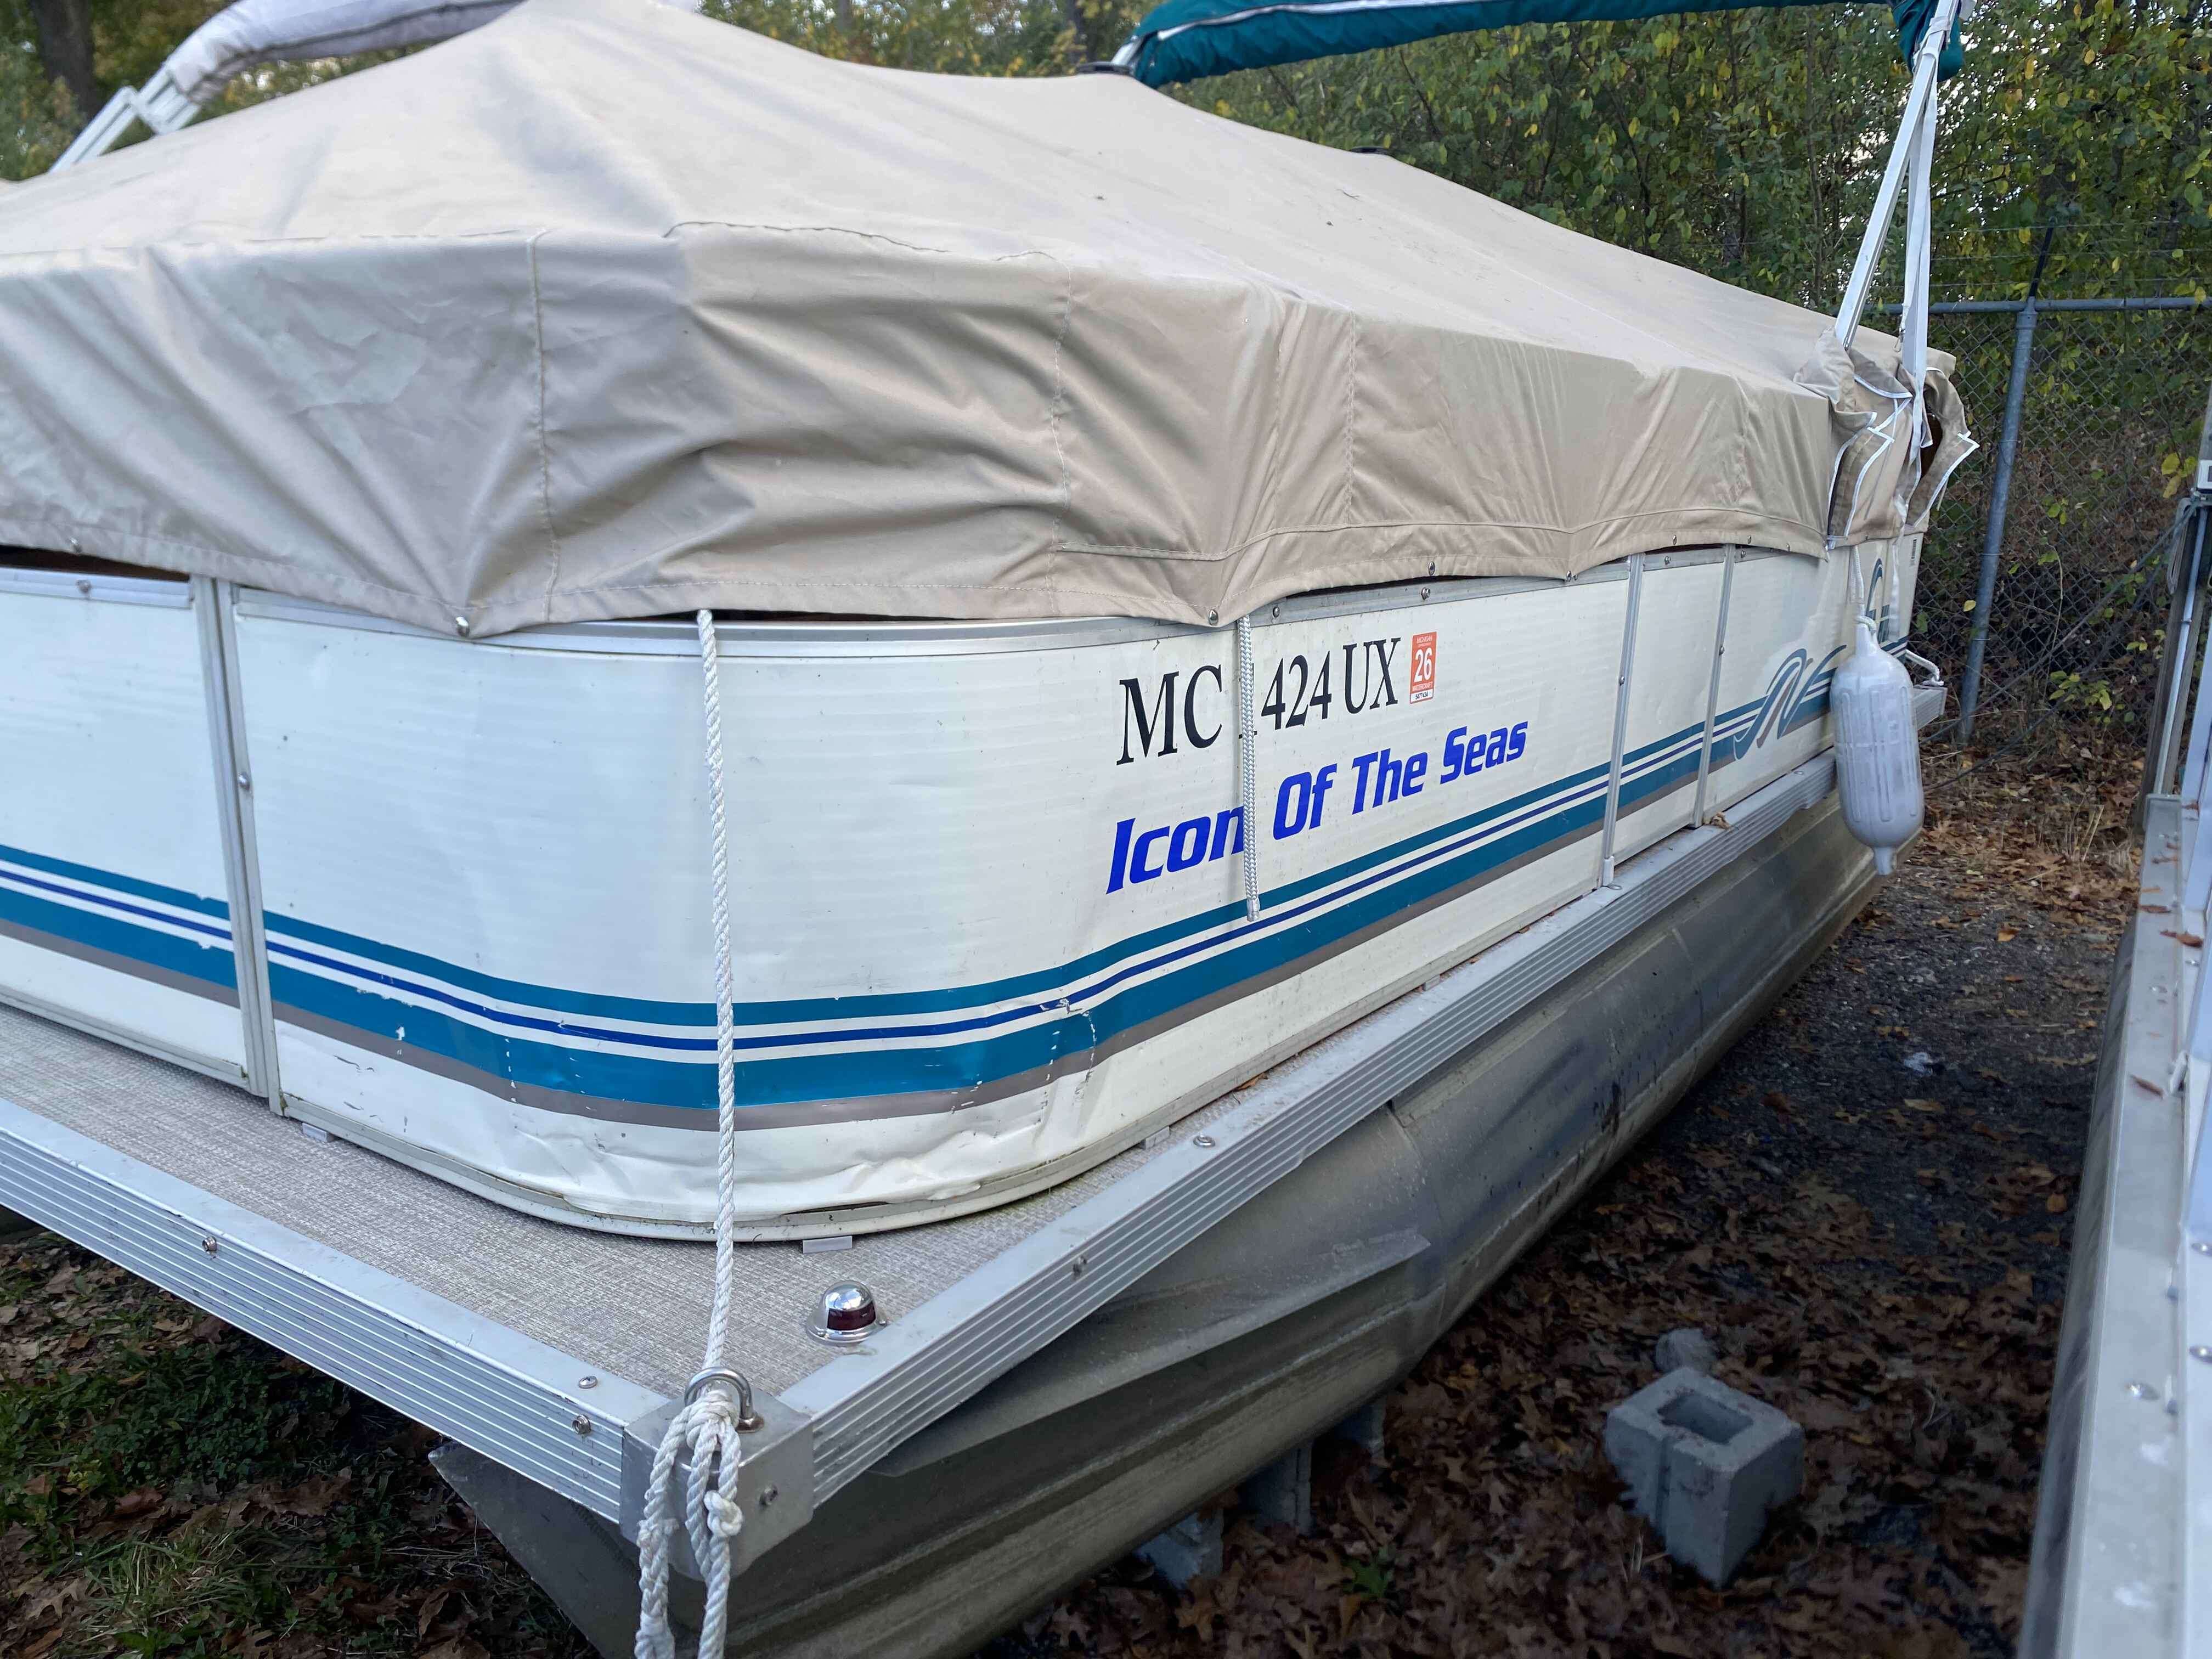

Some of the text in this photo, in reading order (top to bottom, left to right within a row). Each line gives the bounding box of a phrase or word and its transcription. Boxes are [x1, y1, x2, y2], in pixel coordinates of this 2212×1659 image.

[1116, 637, 1401, 766] MC 424 UX
[1413, 647, 1432, 683] 26
[1106, 721, 1528, 894] Icon Of The Seas
